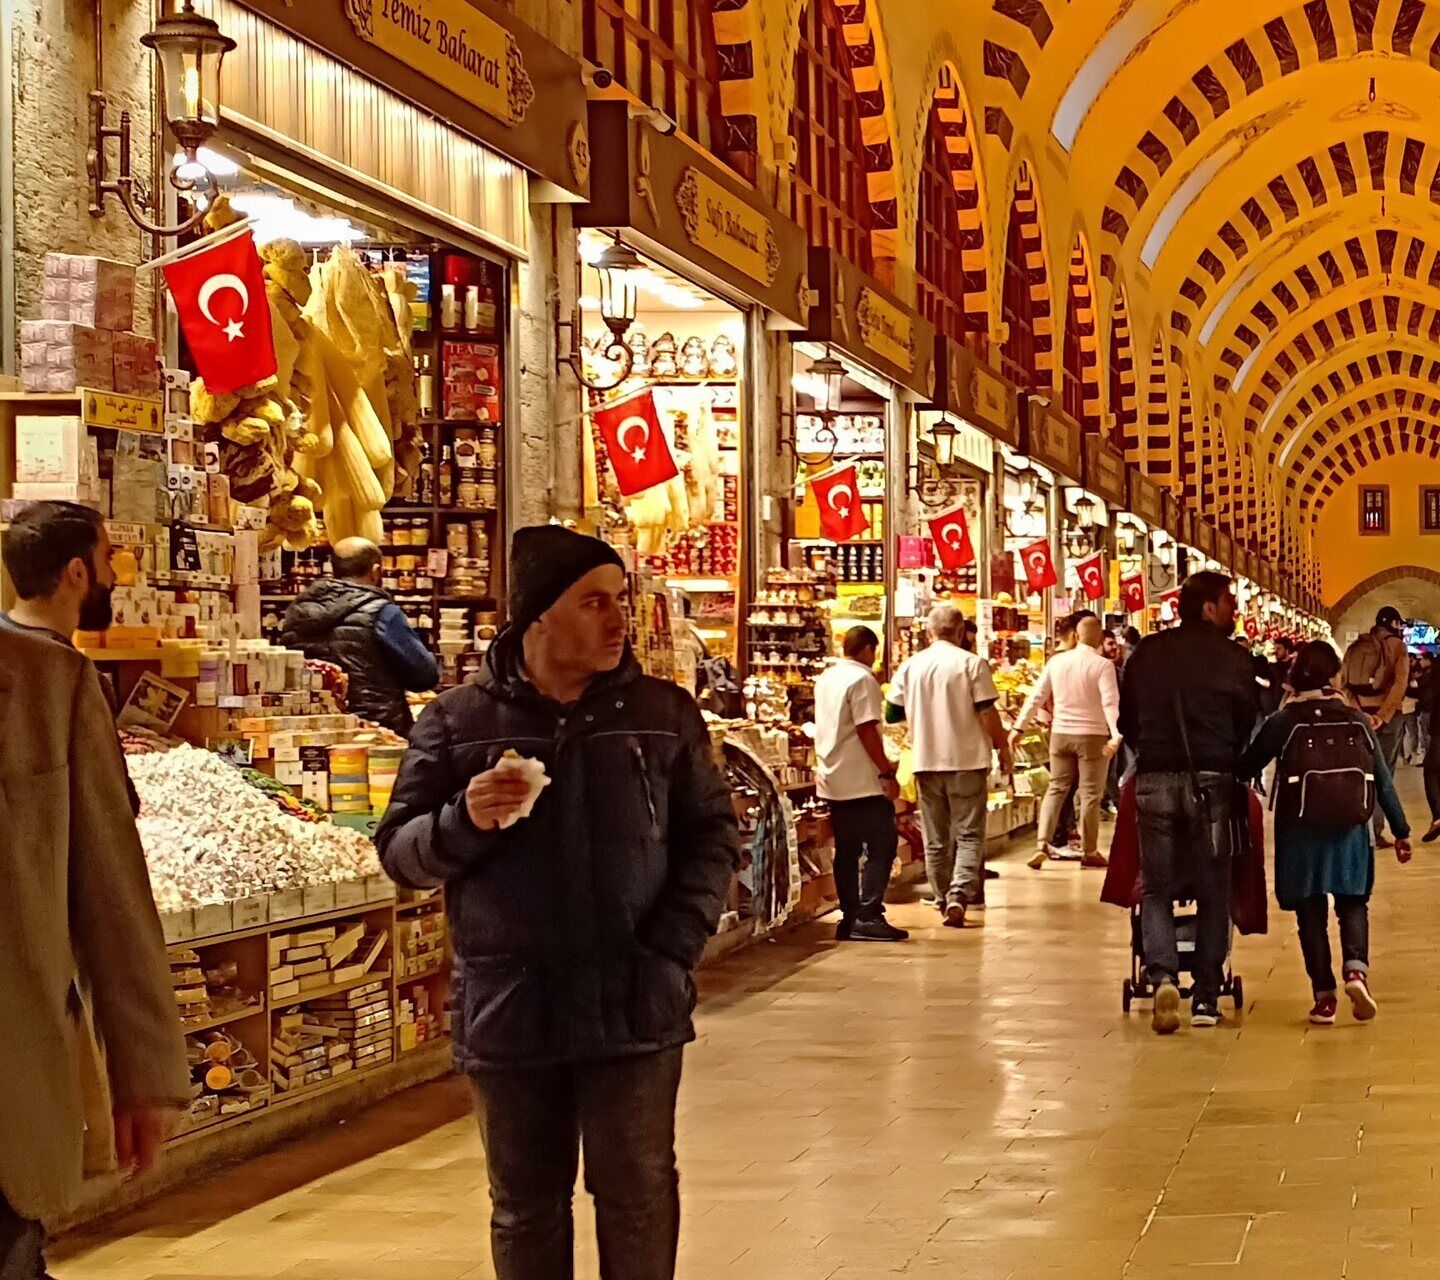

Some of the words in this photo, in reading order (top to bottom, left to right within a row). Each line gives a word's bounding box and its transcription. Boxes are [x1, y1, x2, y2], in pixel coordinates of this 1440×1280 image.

[436, 20, 501, 89] Baharat
[450, 344, 474, 355] TEA
[450, 383, 474, 395] TEA
